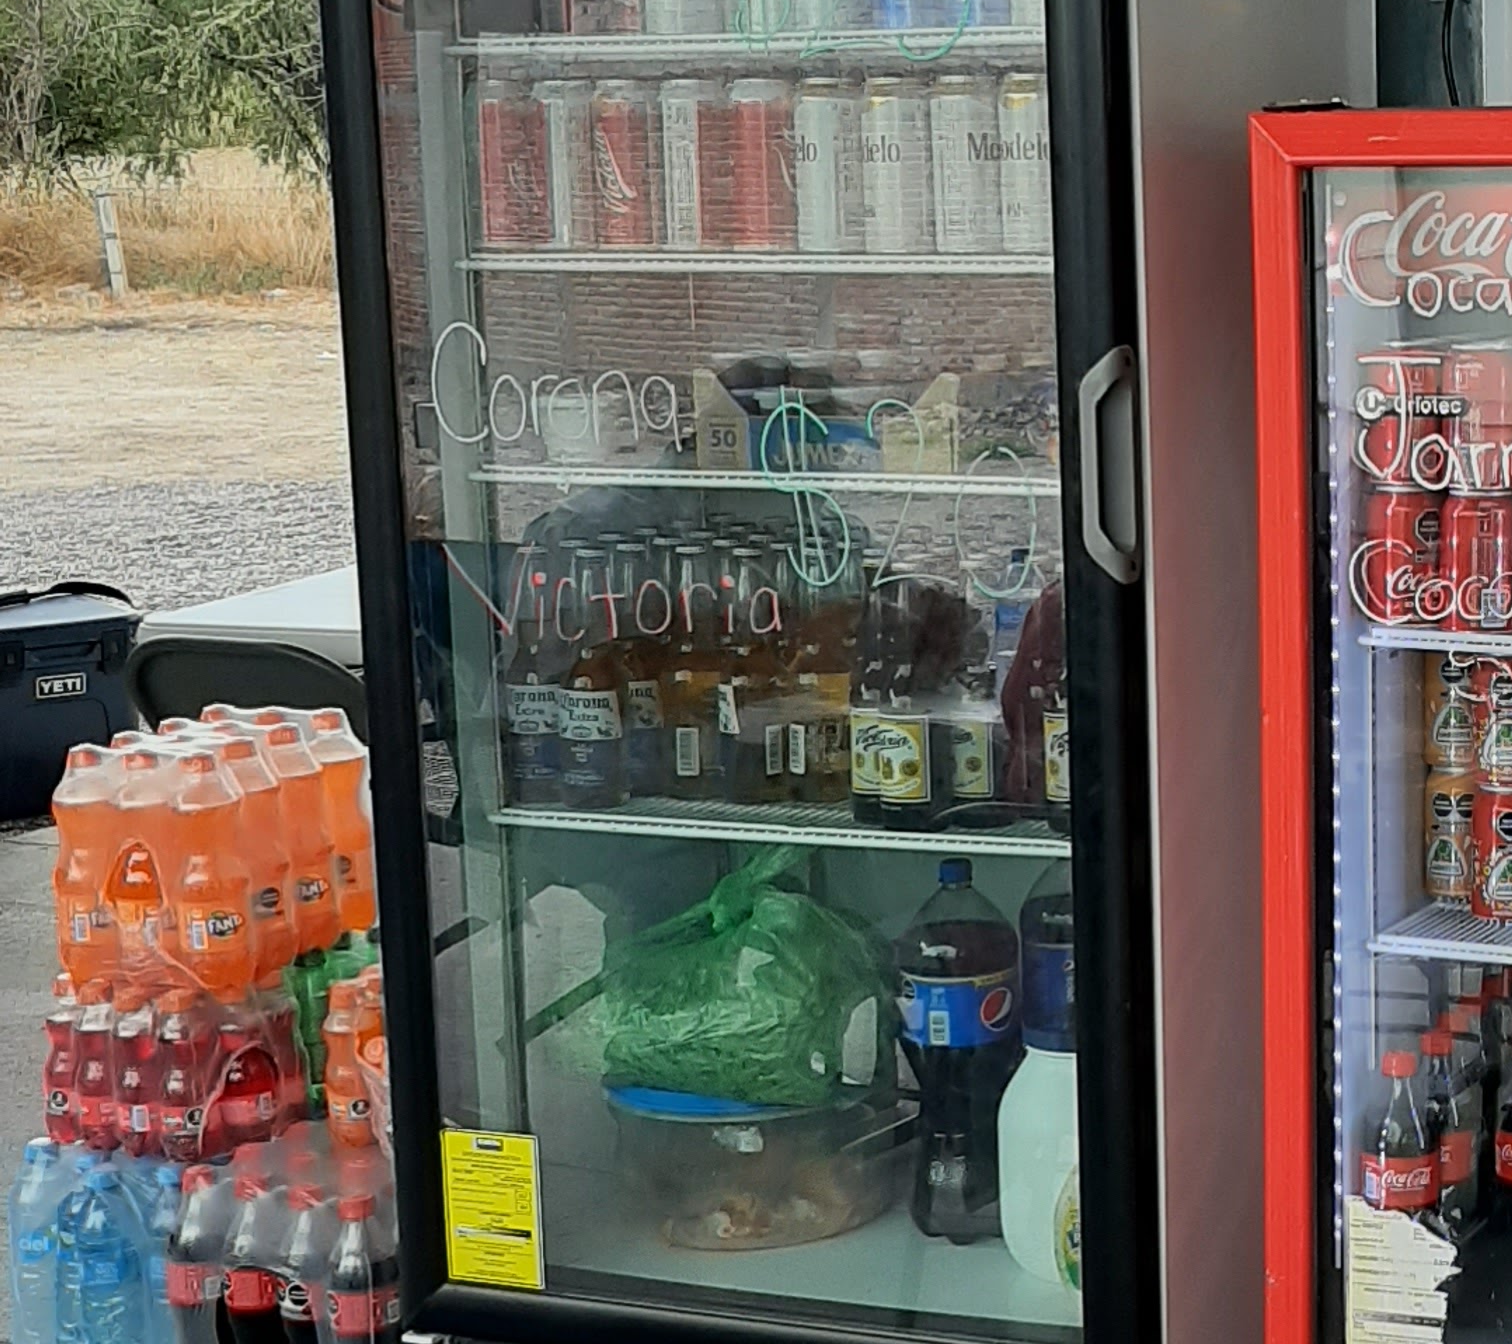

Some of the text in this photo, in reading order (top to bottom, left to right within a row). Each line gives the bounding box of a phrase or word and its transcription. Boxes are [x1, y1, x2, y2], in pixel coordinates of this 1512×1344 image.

[431, 321, 684, 453] Corona
[710, 429, 738, 448] 50
[440, 540, 785, 642] Victoria
[40, 677, 81, 694] YETI
